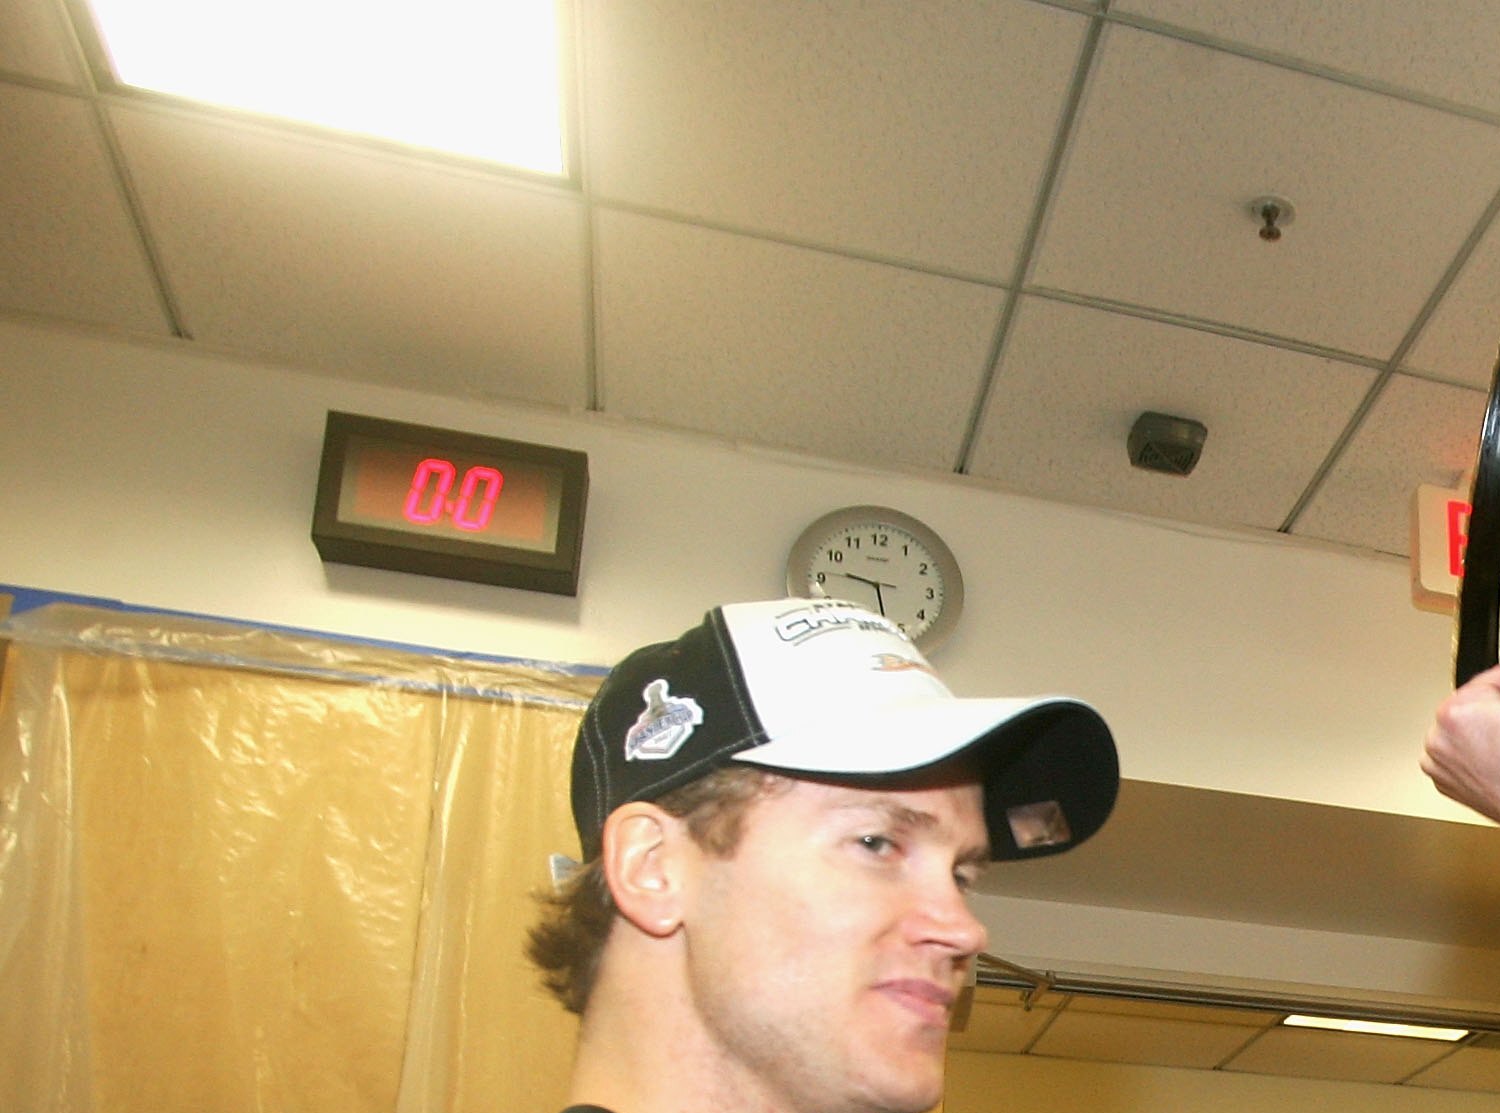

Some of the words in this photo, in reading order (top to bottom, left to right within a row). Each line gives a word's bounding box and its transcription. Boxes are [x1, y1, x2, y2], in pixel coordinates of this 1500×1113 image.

[845, 536, 861, 550] 11
[871, 533, 888, 547] 12
[827, 550, 843, 562] 10
[903, 545, 909, 557] 1
[919, 563, 928, 575] 2
[817, 572, 826, 584] 9
[926, 588, 935, 600] 3
[916, 609, 926, 621] 4
